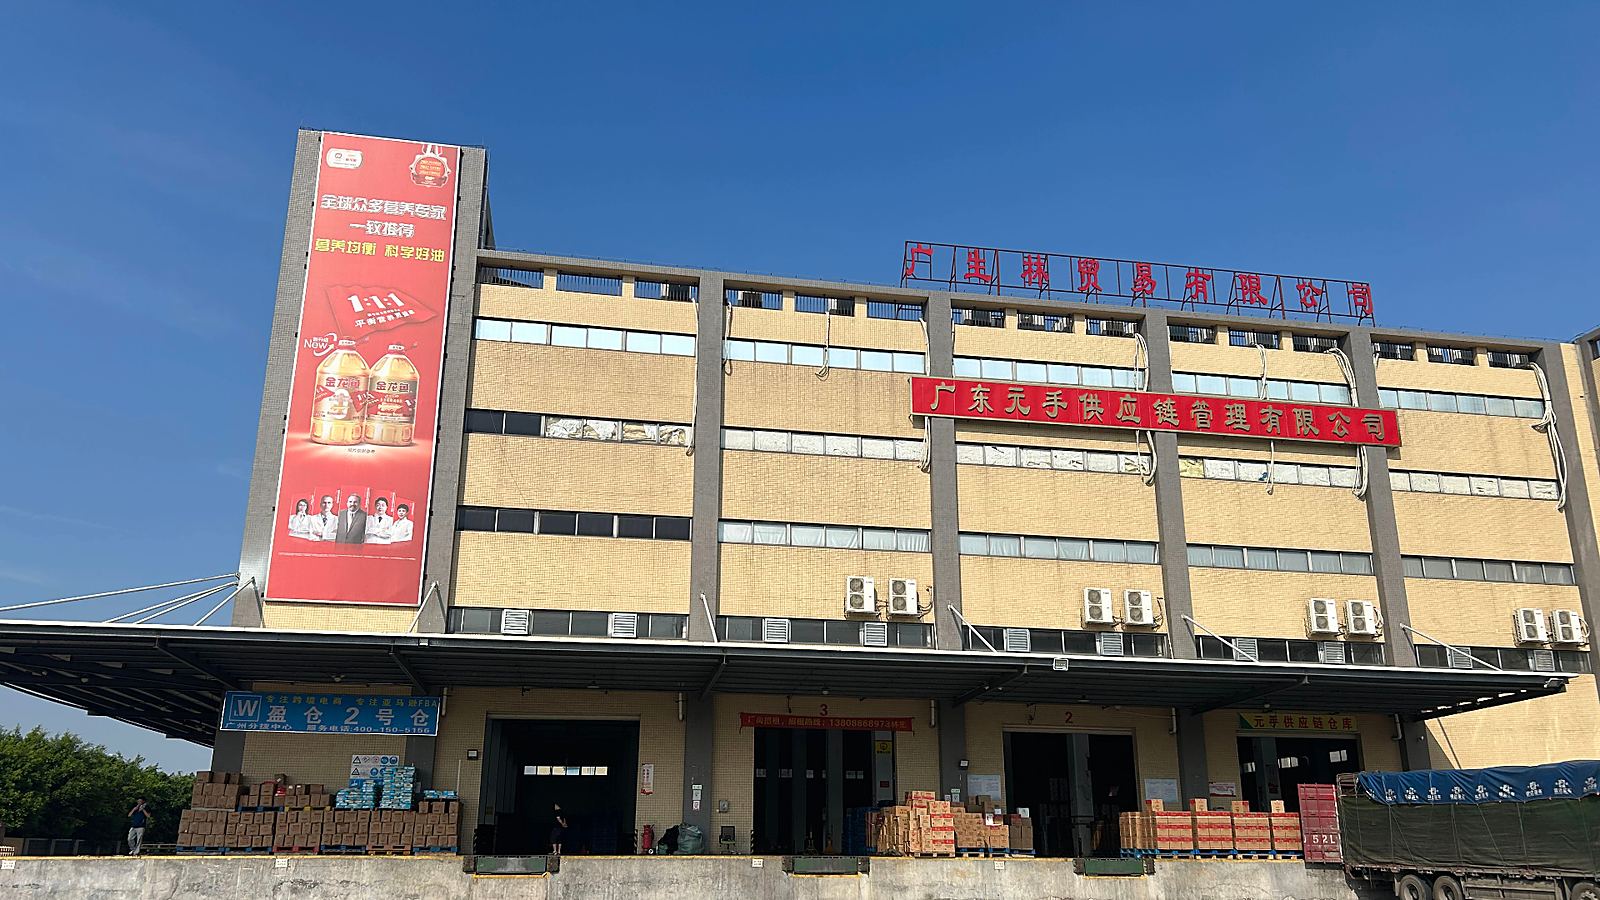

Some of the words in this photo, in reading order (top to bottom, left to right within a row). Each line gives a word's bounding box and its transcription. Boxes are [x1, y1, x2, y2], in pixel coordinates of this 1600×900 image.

[320, 194, 447, 221] 全球众多营养专家
[349, 219, 415, 239] 一致推荐
[315, 238, 377, 256] 营养均衡
[384, 244, 445, 263] 科学好油
[347, 292, 405, 313] 1:1:1
[376, 381, 410, 393] 金龙鱼
[930, 381, 1386, 440] 广东元手供应链管理有限公司
[266, 705, 430, 727] 盈仓2号仓
[820, 703, 829, 717] 3
[1065, 711, 1073, 723] 2
